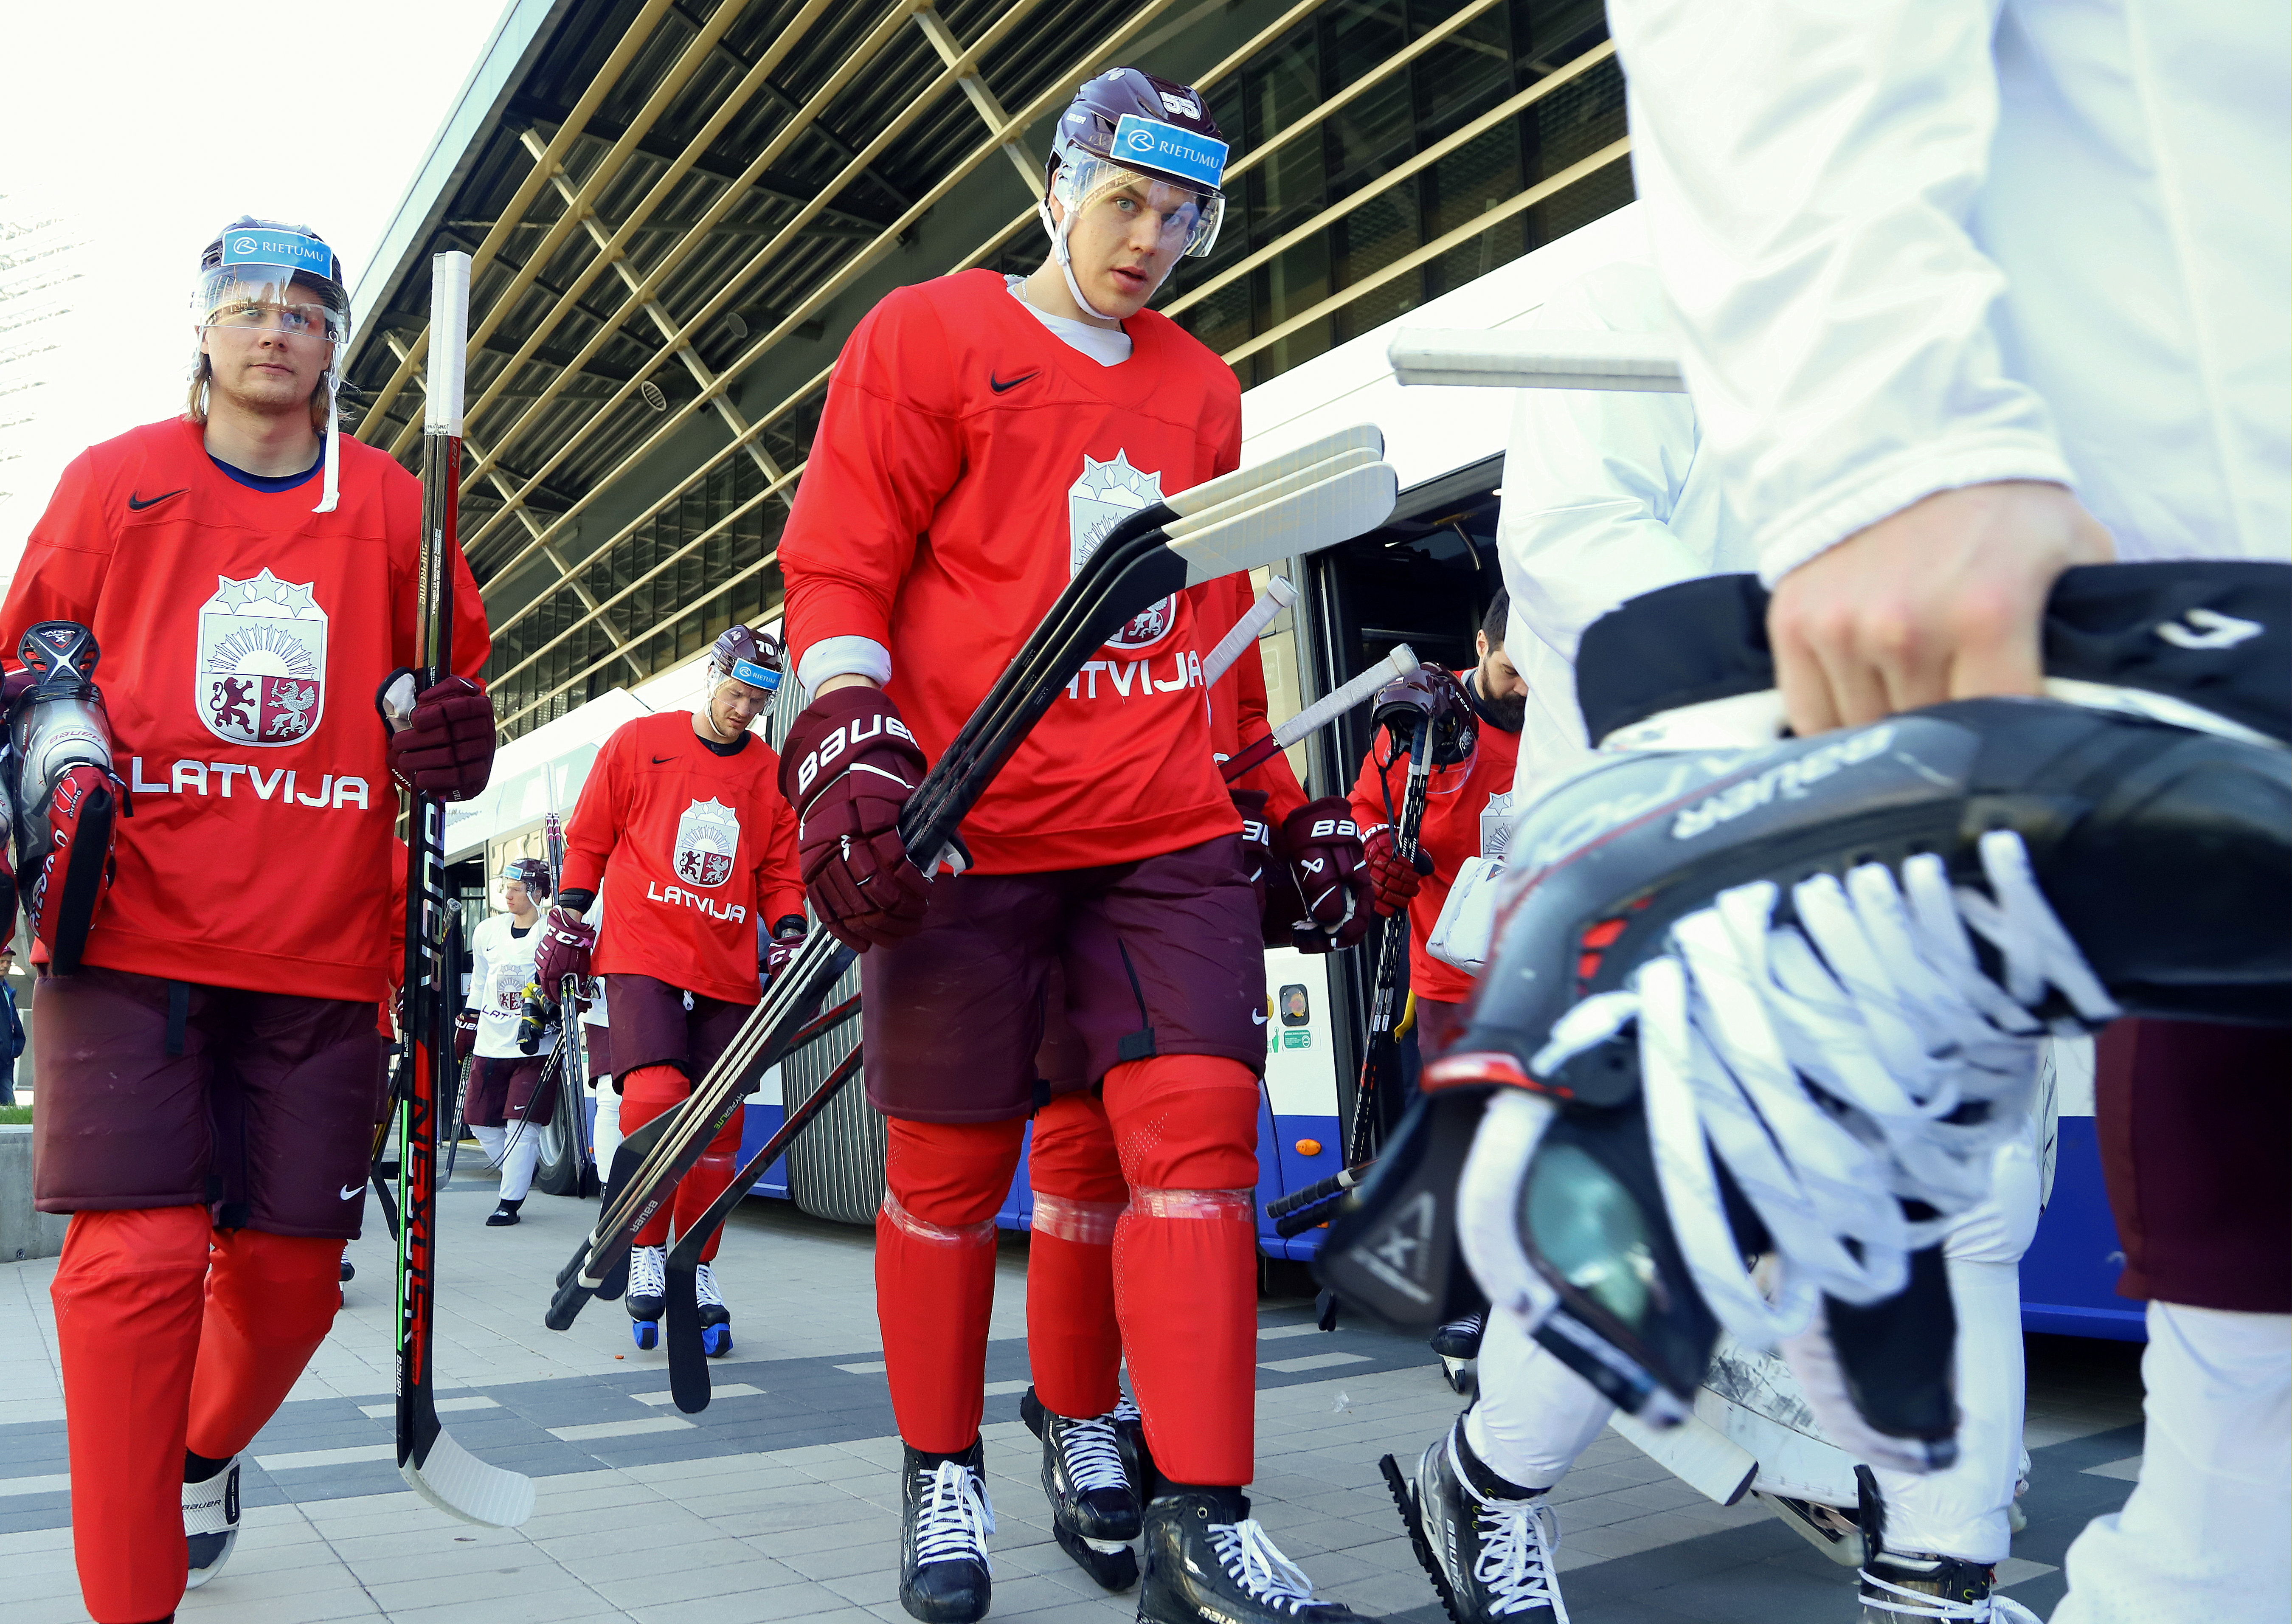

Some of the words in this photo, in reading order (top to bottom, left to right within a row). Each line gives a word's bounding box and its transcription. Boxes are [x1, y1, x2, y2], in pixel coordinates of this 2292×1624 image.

[1159, 91, 1201, 121] 55
[1159, 141, 1220, 169] RIETUMU
[262, 241, 323, 262] RIETUMU
[419, 541, 428, 605] SUPREME
[712, 646, 722, 656] CCM
[755, 639, 775, 656] 70
[1455, 691, 1470, 712] CCM
[50, 730, 102, 744] BAUER
[798, 714, 920, 796] BAUE
[132, 756, 370, 810] LATVIJA
[421, 802, 445, 992] AUER
[647, 881, 747, 924] LATVIJA
[713, 1092, 745, 1130] HYPERLITE
[411, 1095, 429, 1323] NEXUS
[629, 1199, 658, 1233] BAUER
[182, 1500, 221, 1510] BAUER
